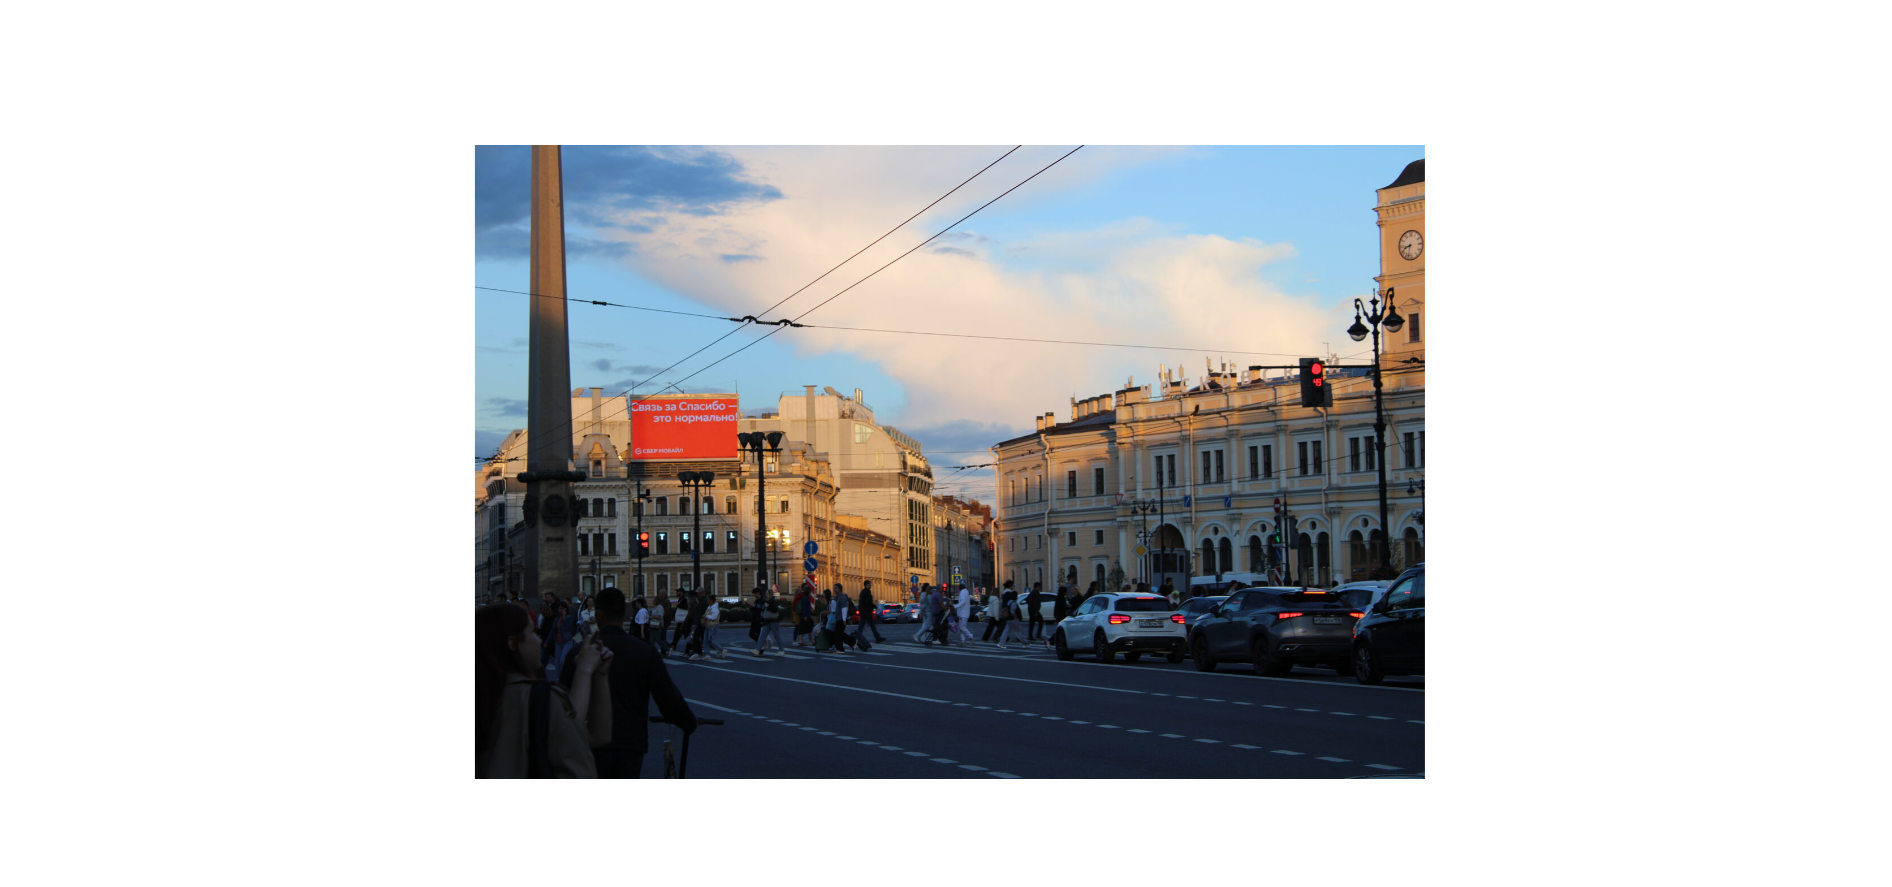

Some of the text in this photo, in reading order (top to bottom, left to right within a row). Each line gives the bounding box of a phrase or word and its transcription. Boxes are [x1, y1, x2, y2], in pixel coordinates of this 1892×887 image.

[1140, 353, 1340, 399] МОСКОВСКЙ
[632, 402, 663, 412] Связь
[664, 403, 677, 411] за
[678, 401, 726, 411] Спасибо
[653, 412, 738, 424] это нормально!
